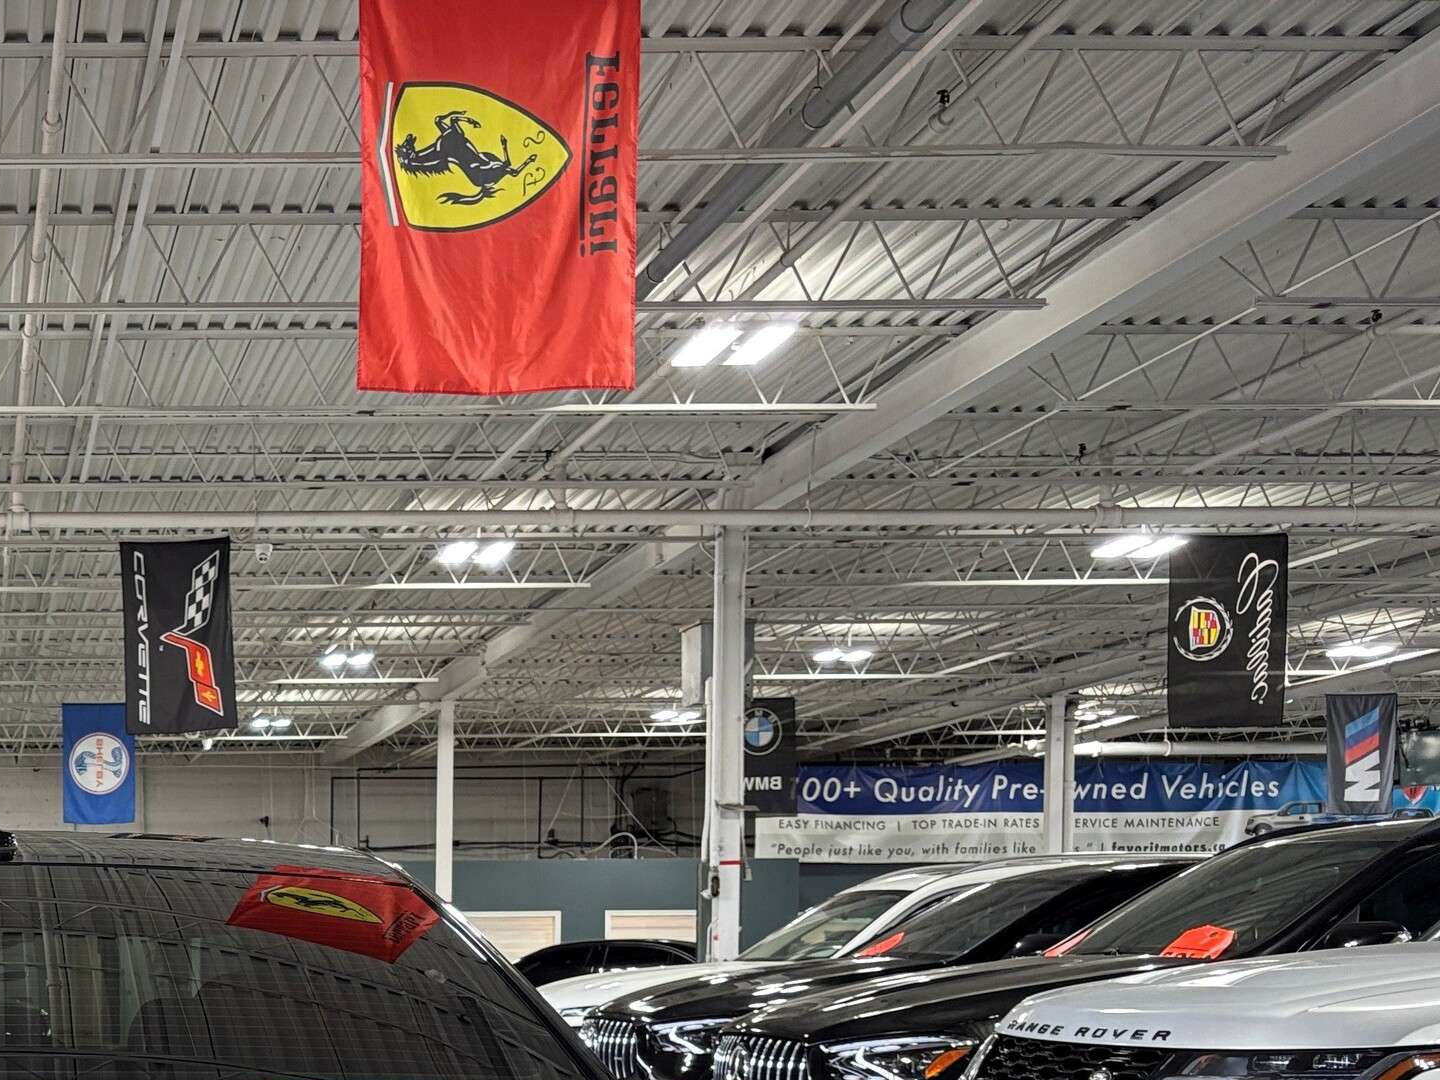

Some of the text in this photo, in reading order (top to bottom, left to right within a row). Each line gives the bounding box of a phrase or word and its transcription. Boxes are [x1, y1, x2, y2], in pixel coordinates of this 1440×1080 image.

[133, 551, 151, 725] CORVETTE
[874, 775, 981, 808] Quality
[1162, 770, 1280, 799] Vehicles
[778, 816, 1220, 831] EASY FINANCING TOP TRADE-IN RATES ERVICE MAINTENANCE
[828, 844, 853, 858] just
[859, 844, 882, 856] like
[888, 846, 915, 859] you,
[921, 843, 949, 855] with
[954, 843, 1008, 855] families
[1013, 842, 1037, 854] like
[1007, 1020, 1172, 1042] RANGE ROVER
